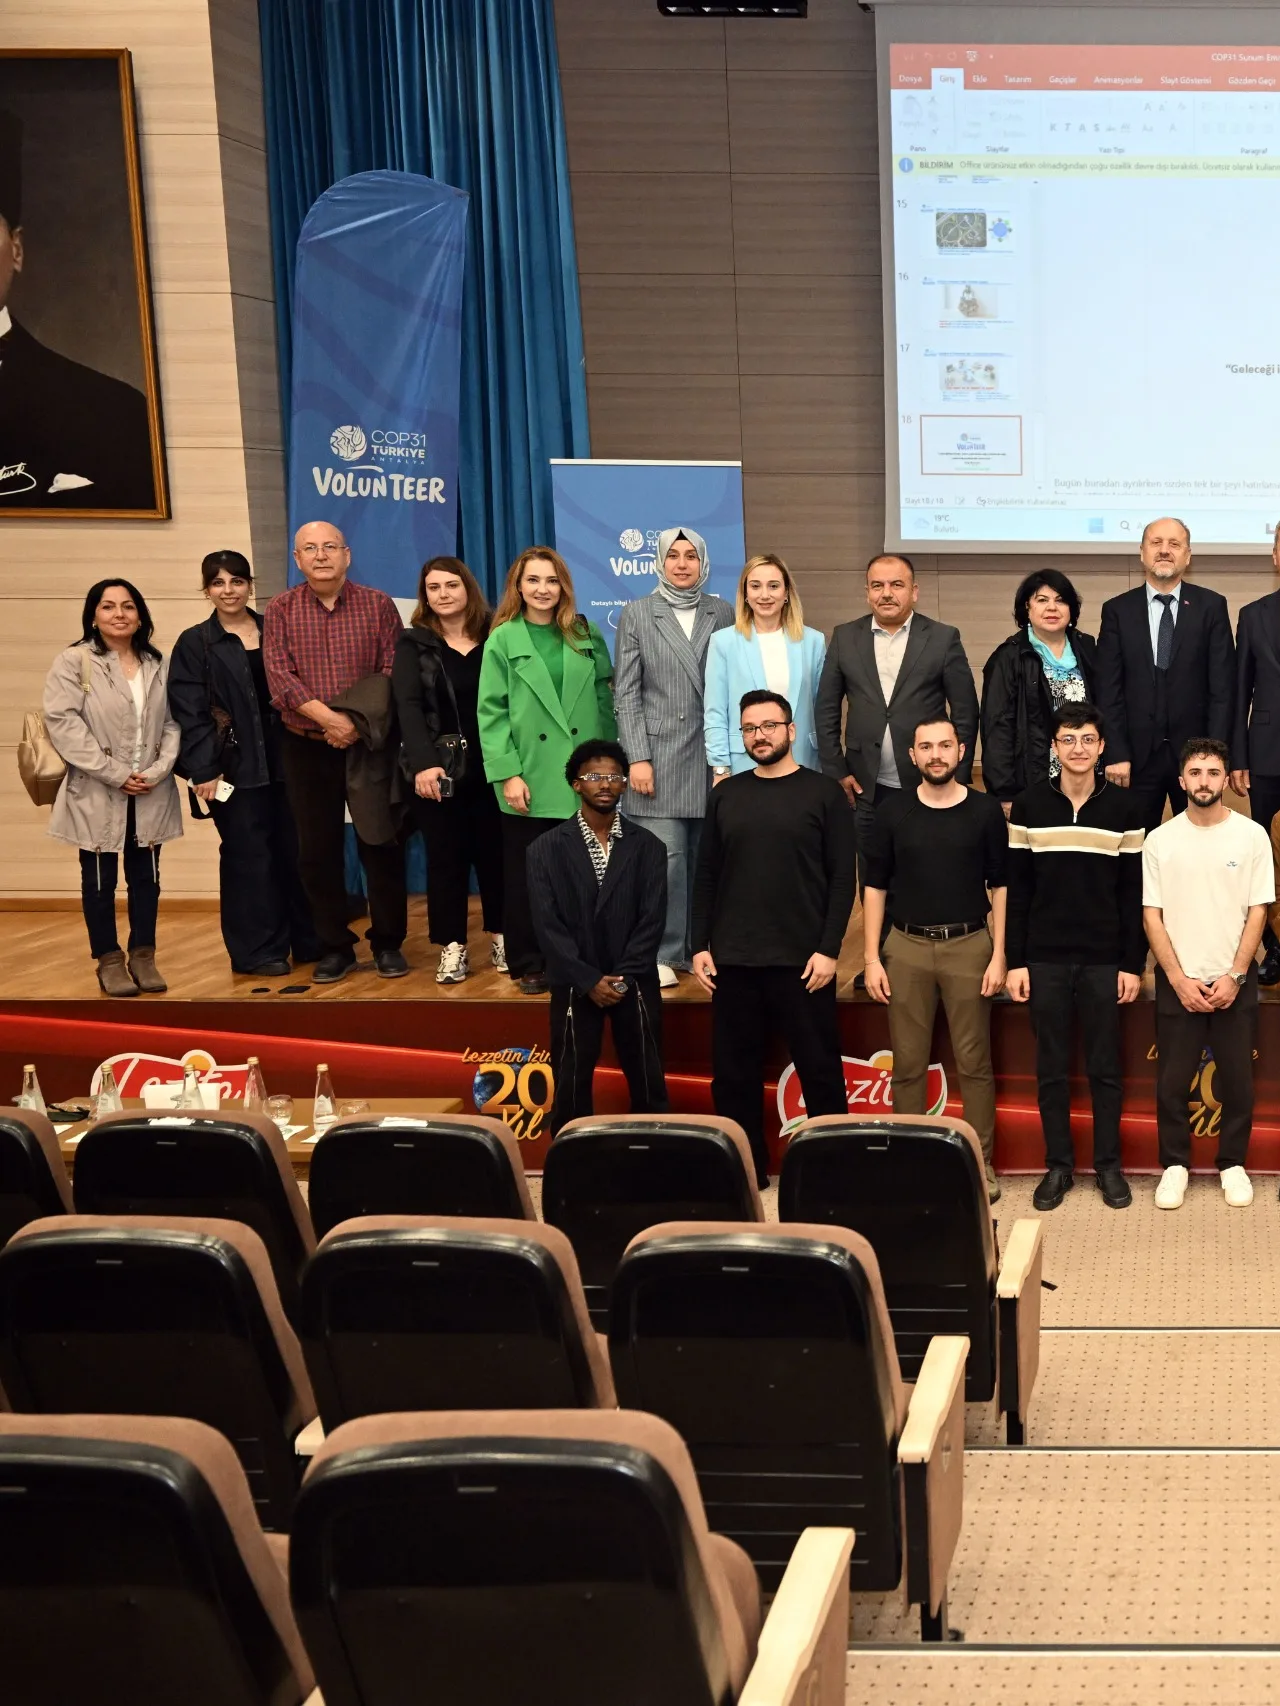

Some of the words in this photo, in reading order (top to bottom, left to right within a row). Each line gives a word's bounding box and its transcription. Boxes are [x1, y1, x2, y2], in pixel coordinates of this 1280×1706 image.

[1211, 53, 1237, 63] COP31
[1239, 53, 1265, 63] Sunum
[898, 75, 923, 84] Dosya
[972, 75, 988, 83] Ekle
[1003, 75, 1032, 84] Tasarım
[1093, 76, 1144, 86] Animasyonlar
[1160, 76, 1179, 86] Slayt
[1180, 76, 1212, 85] Gösterisi
[1228, 76, 1255, 85] Gözden
[910, 145, 927, 153] Pano
[1240, 147, 1268, 156] Paragraf
[959, 161, 982, 170] Office
[1134, 161, 1155, 171] devre
[1202, 162, 1230, 171] Ücretsiz
[896, 199, 908, 209] 15
[898, 272, 909, 282] 16
[900, 343, 910, 353] 17
[901, 414, 912, 424] 18
[371, 429, 426, 447] COP31
[371, 444, 426, 459] TÜRKİYE
[371, 456, 425, 465] ANTALYA
[312, 466, 446, 504] VOLUNTEER
[1054, 479, 1082, 489] Bugün
[1084, 479, 1119, 487] buradan
[1164, 479, 1191, 488] sizden
[1193, 479, 1208, 488] tek
[904, 496, 921, 506] Slayt
[933, 514, 950, 522] 19°C
[610, 557, 657, 577] VOLUN
[461, 1047, 525, 1063] Lezzetin
[479, 1063, 555, 1115] 20
